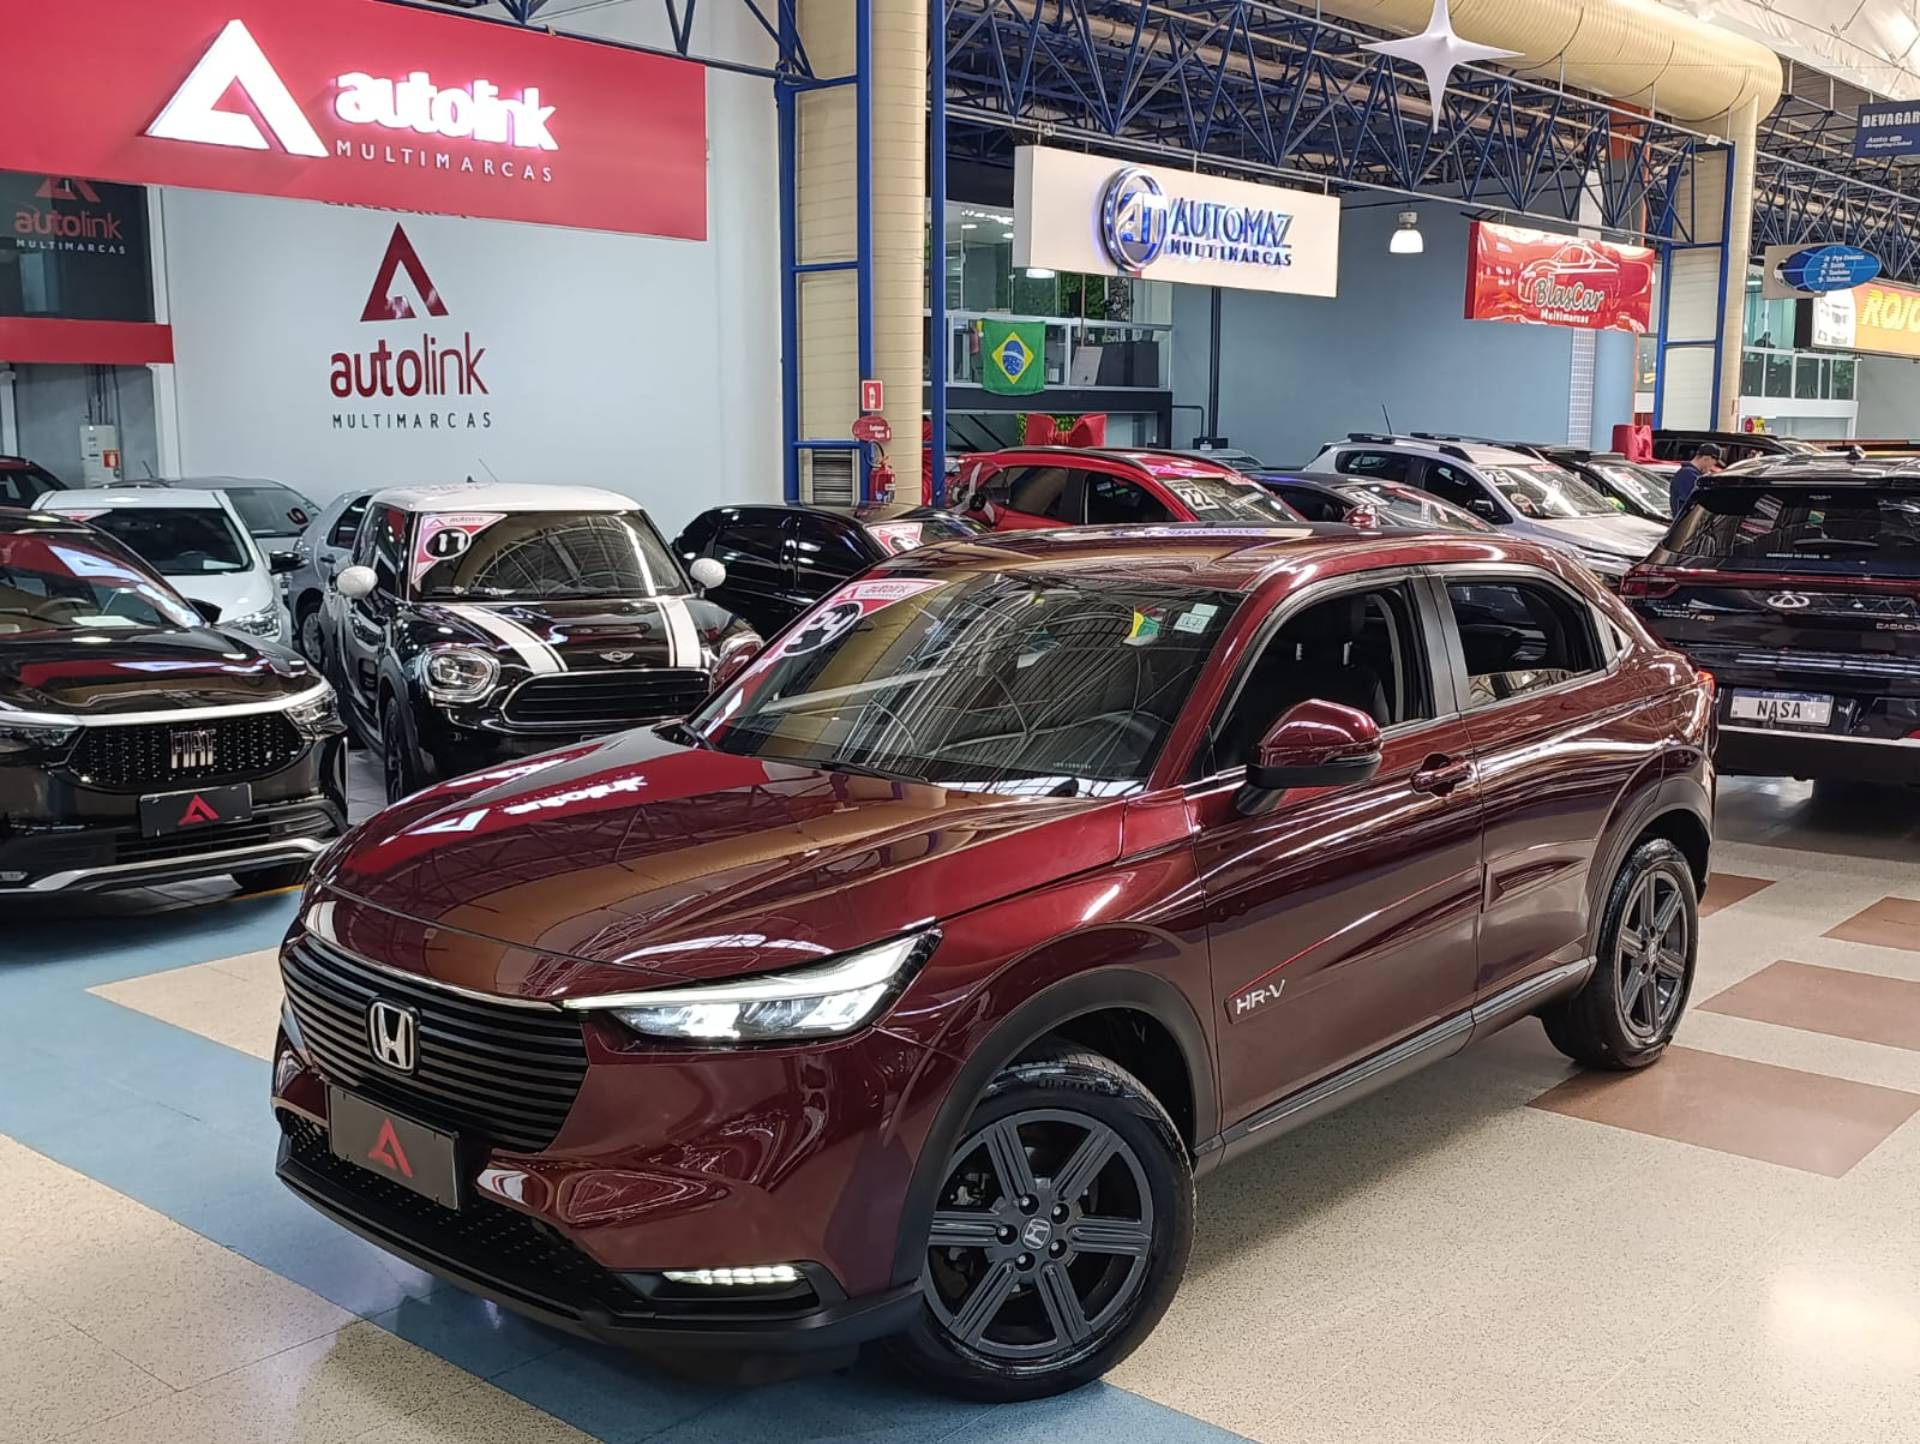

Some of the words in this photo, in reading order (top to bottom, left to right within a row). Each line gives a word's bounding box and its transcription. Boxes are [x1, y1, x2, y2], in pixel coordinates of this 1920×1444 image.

[335, 71, 557, 151] autolink
[1861, 110, 1920, 128] DEVAGAR
[336, 140, 554, 183] MULTIMARCAS
[14, 205, 122, 240] autolink
[1171, 197, 1294, 249] AUTOMAZ
[16, 239, 126, 255] MULTIMARCAS
[1170, 239, 1292, 266] MULTIMARCAS
[1535, 276, 1605, 311] BlasCar
[1540, 310, 1590, 324] Multimarcas
[330, 331, 489, 397] autolink
[332, 411, 491, 429] MULTIMARCAS
[1180, 489, 1213, 508] 22
[438, 533, 466, 553] 17
[1756, 700, 1801, 720] NASA
[169, 729, 217, 769] FIAT
[1236, 979, 1285, 1015] HR-V
